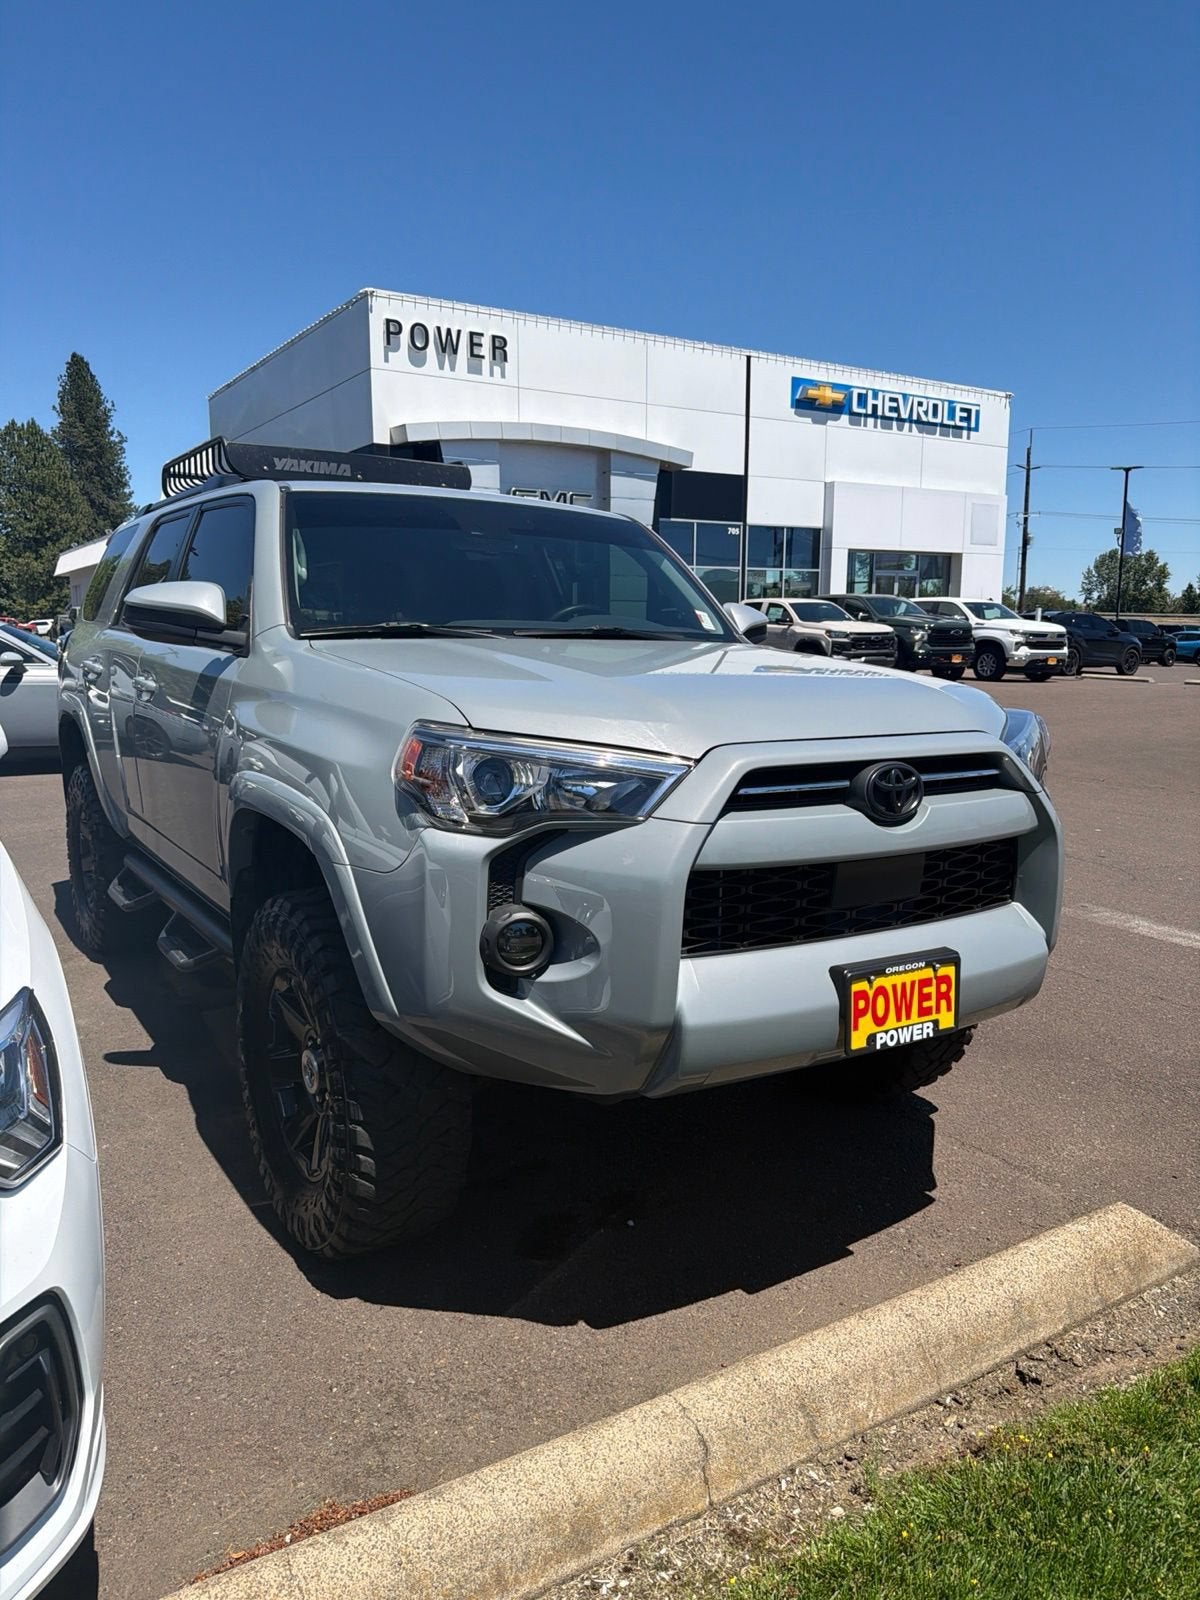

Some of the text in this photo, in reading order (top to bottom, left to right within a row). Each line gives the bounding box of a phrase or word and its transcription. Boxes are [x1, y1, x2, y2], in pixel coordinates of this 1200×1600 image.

[385, 318, 508, 362] POWER
[852, 388, 980, 428] CHEVROLET
[272, 457, 352, 477] YAKIMA
[727, 527, 740, 535] 705
[885, 961, 926, 974] OREGON
[852, 974, 953, 1032] POWER
[876, 1021, 934, 1050] POWER
